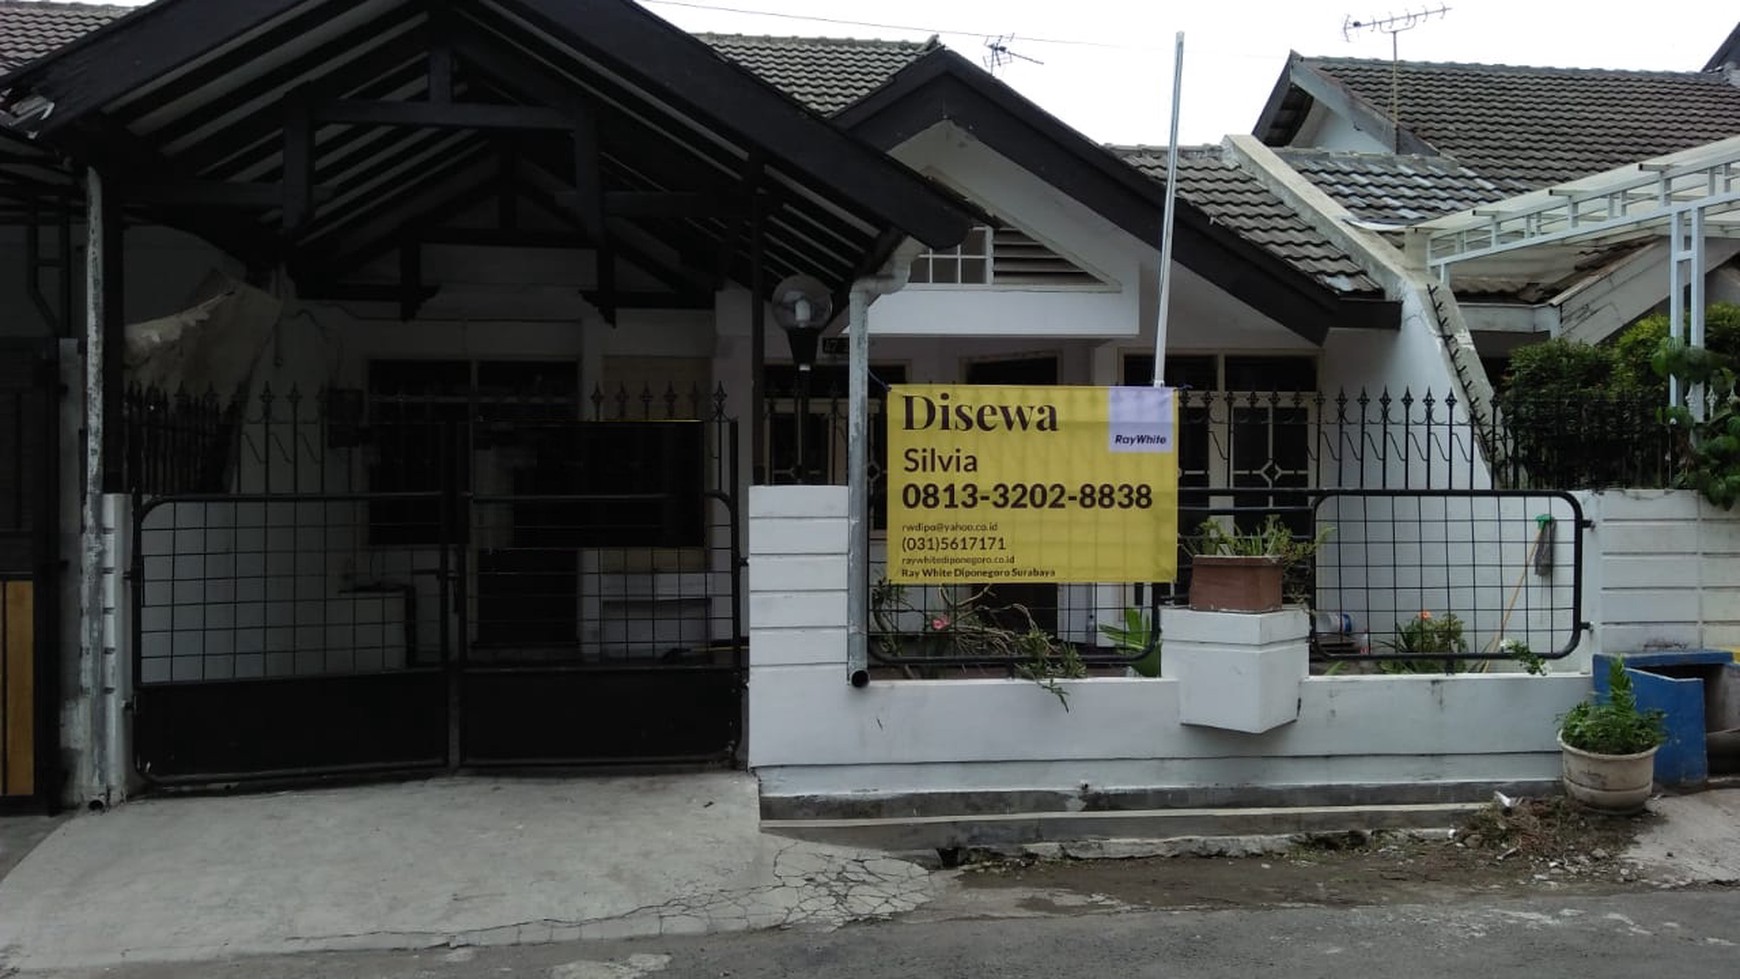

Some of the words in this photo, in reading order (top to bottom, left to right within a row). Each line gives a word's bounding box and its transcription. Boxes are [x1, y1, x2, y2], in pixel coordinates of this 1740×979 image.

[903, 392, 1059, 432] Disewa
[904, 447, 978, 473] Silvia
[902, 483, 1153, 510] 0813-3202-8838
[902, 522, 999, 534] rwdipo@yahoo.co.id
[902, 537, 1006, 552] (031)5617171
[902, 555, 1015, 566] raywhitediponegoro.co.id
[902, 568, 920, 579] Ray
[922, 568, 952, 578] White
[954, 568, 1011, 579] Diponegoro
[1012, 568, 1056, 578] Surabaya
